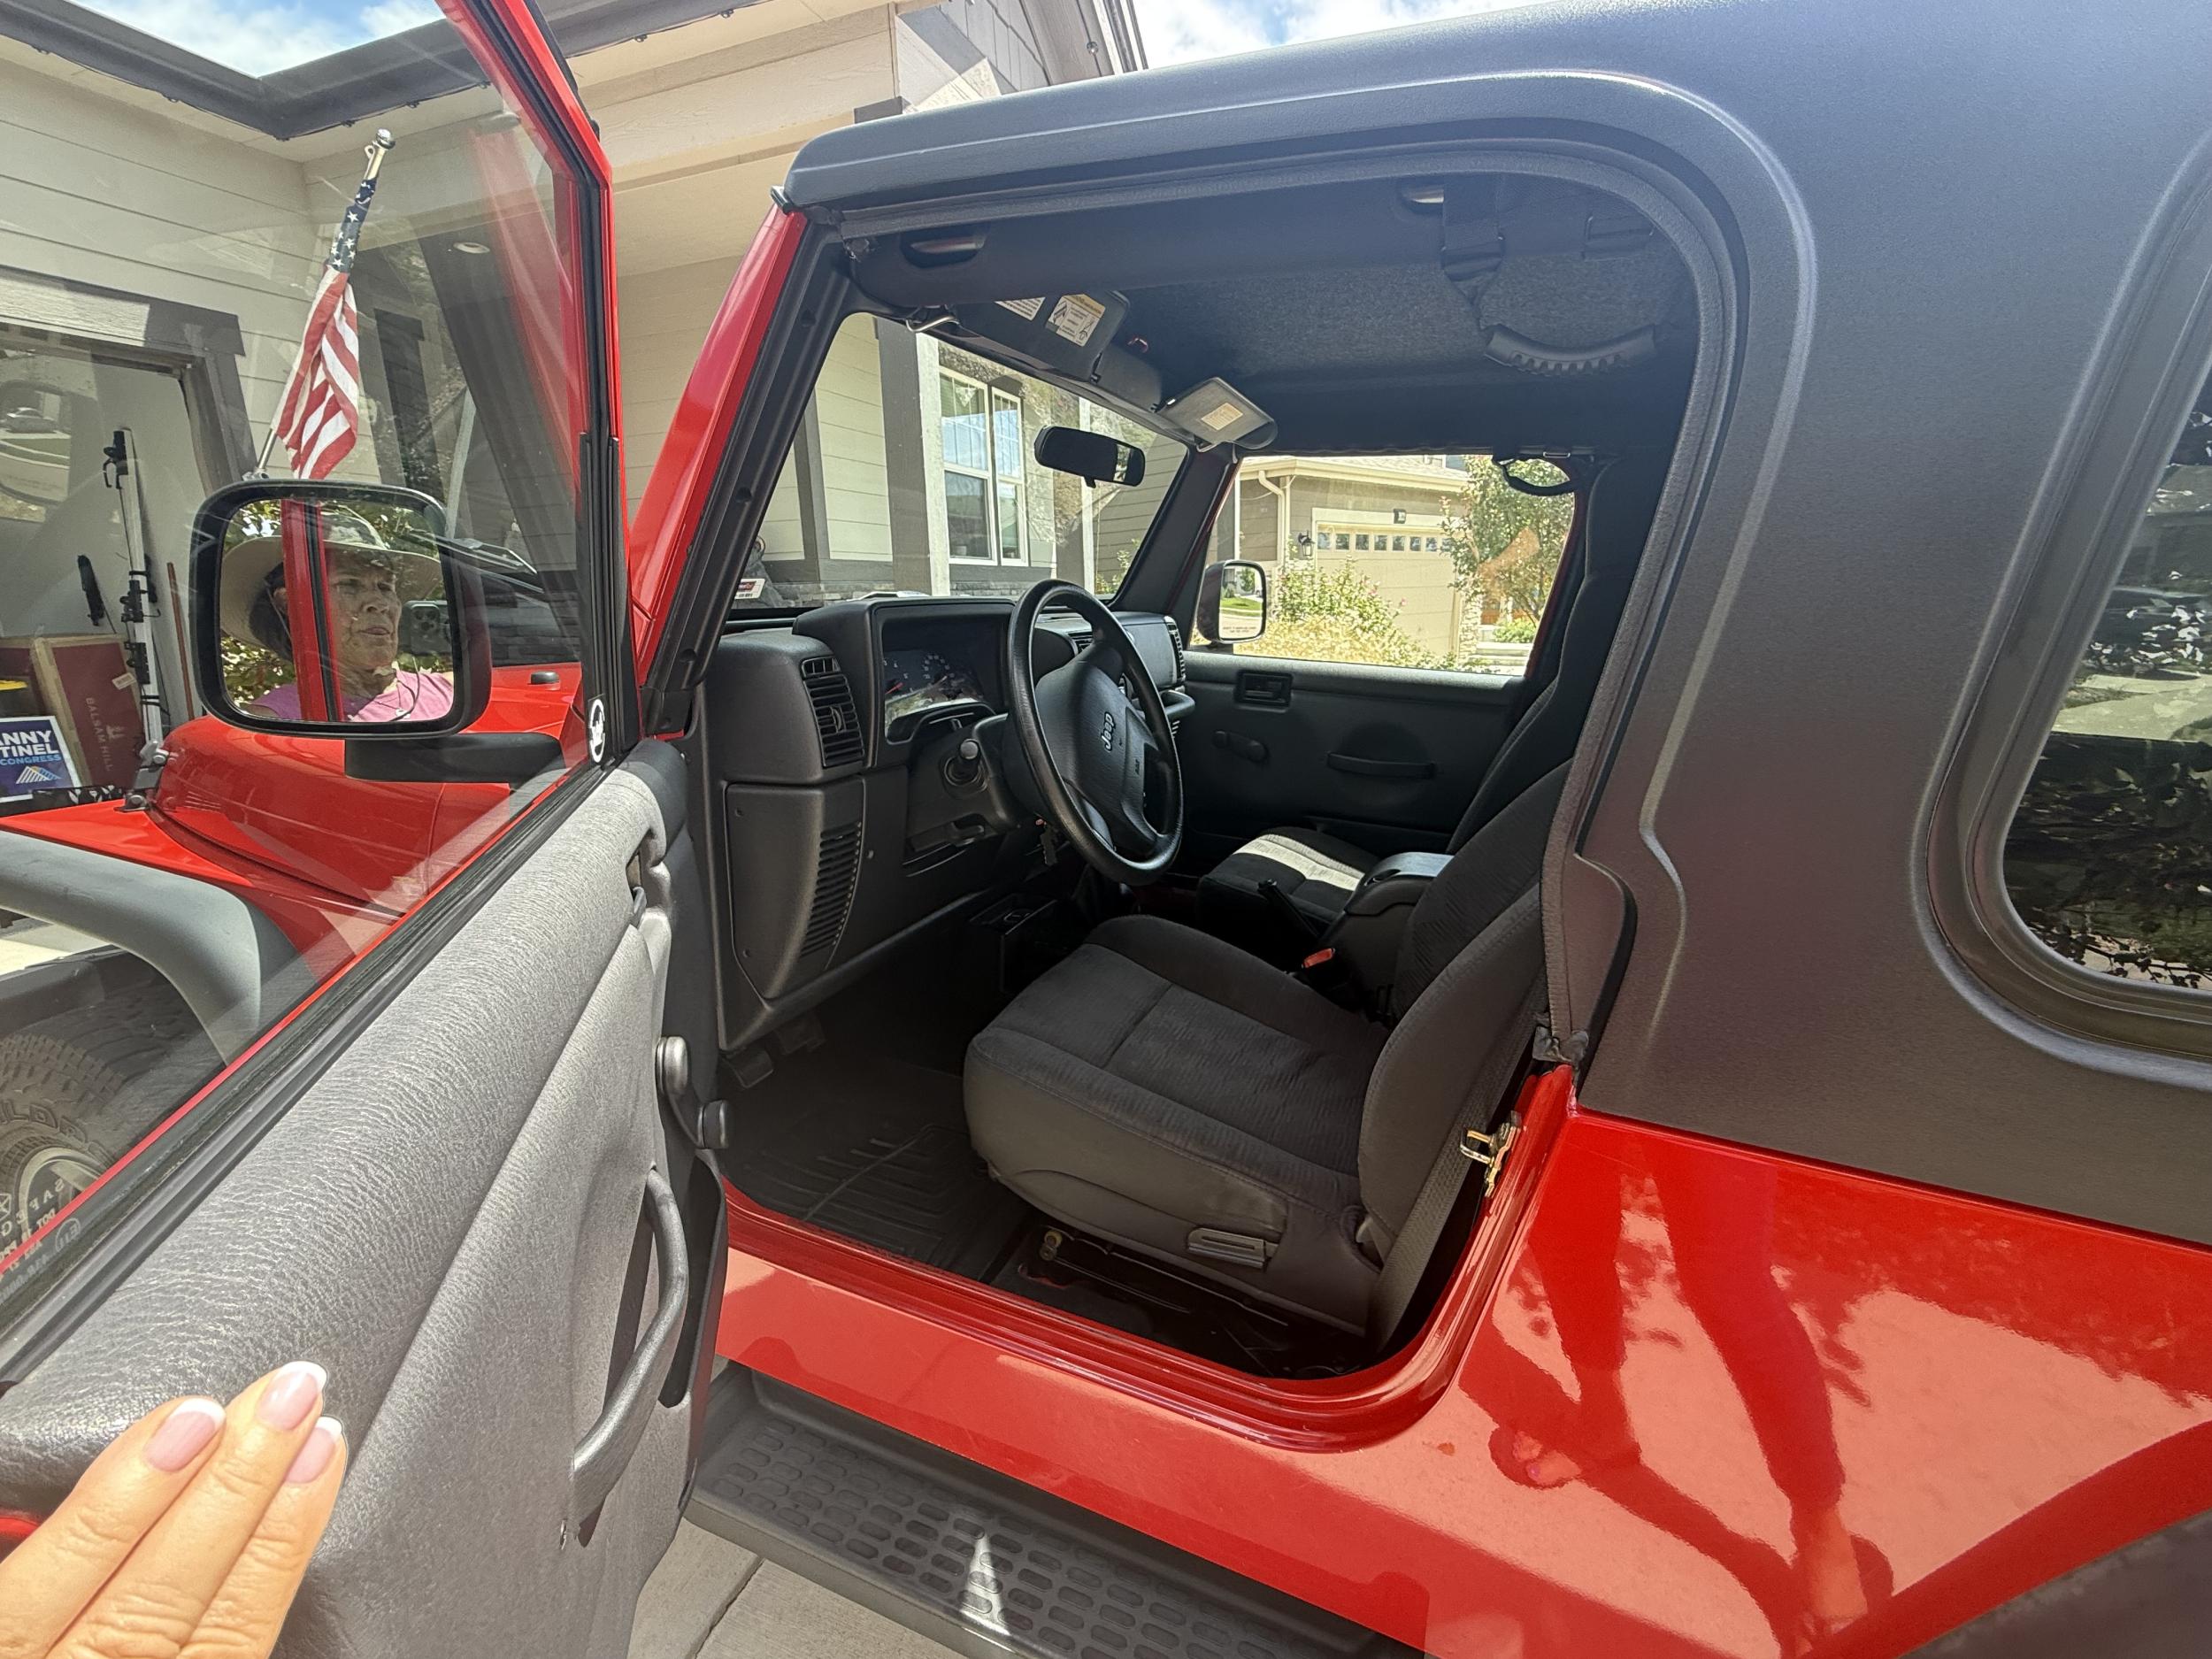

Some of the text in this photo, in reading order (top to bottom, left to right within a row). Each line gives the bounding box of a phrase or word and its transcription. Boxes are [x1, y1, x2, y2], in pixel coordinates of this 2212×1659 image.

[0, 730, 51, 746] NNY
[86, 697, 114, 772] BALSAM HILL
[1101, 711, 1116, 752] Jeep
[0, 743, 59, 758] TINEL
[0, 754, 62, 765] CONGRESS
